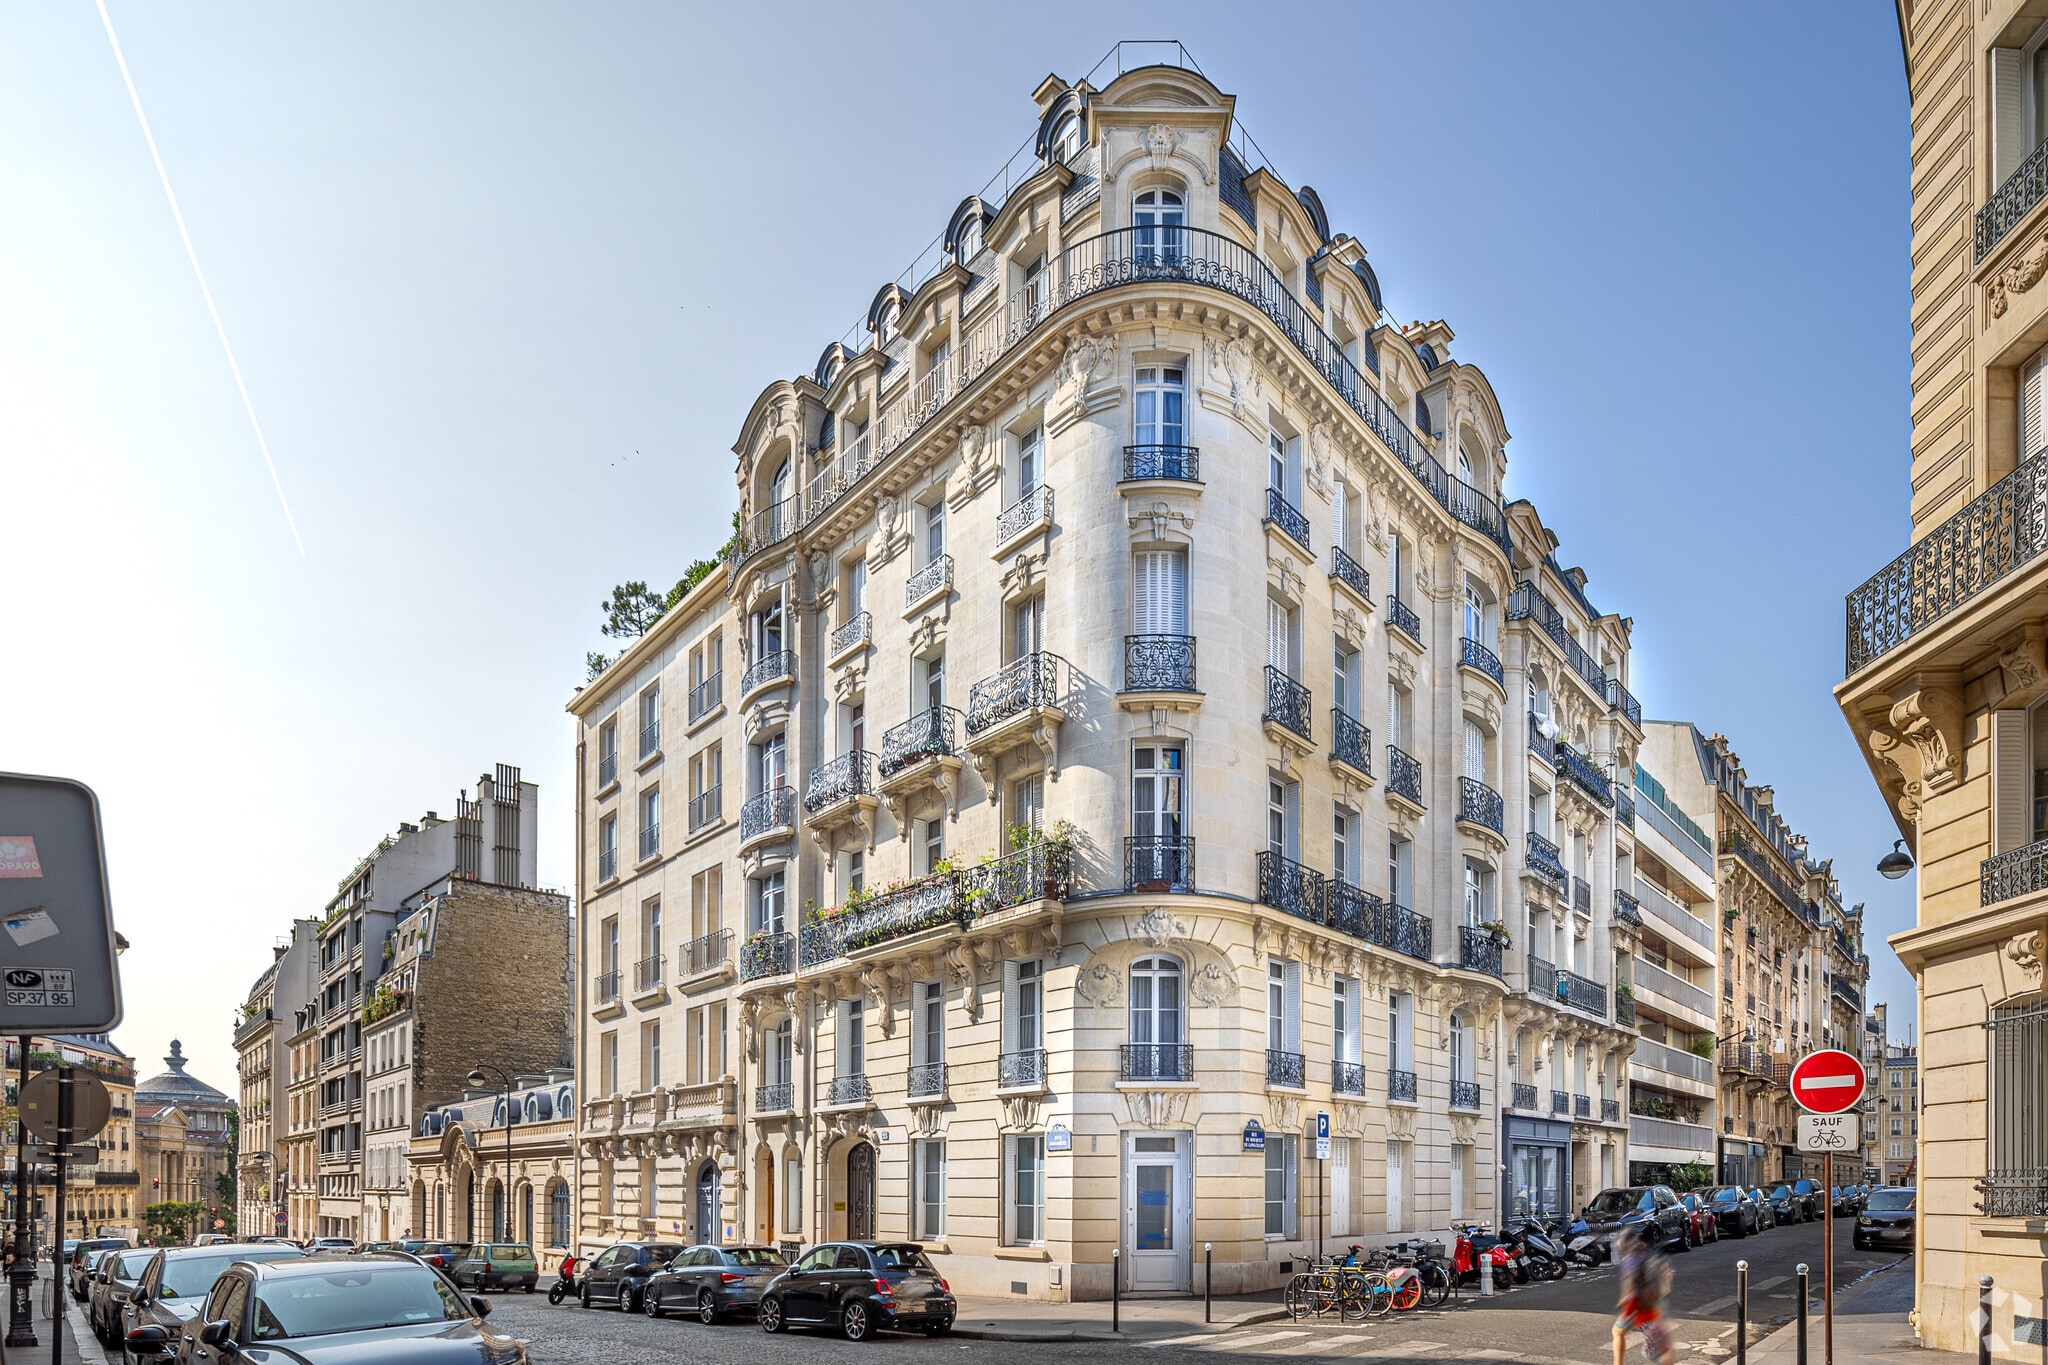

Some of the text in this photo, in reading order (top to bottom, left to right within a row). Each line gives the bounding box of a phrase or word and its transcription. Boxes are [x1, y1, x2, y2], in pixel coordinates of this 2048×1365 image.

[11, 972, 35, 984] NF
[8, 992, 43, 1004] SP.37
[51, 992, 69, 1005] 95
[1320, 1118, 1326, 1134] P
[1812, 1117, 1843, 1126] SAUF
